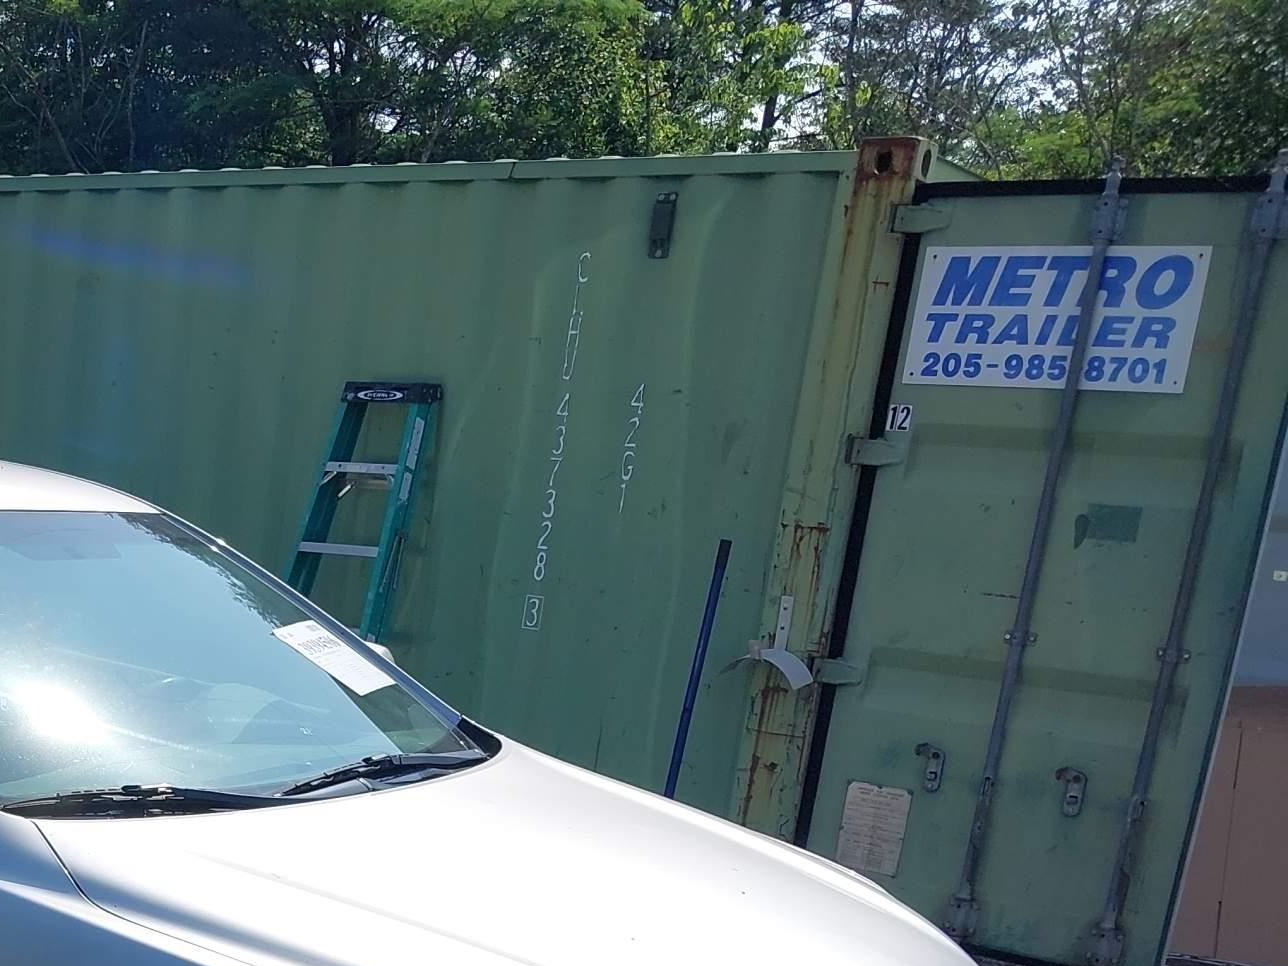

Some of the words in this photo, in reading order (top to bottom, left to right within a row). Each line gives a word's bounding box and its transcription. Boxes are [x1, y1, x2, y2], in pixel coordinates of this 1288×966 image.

[932, 254, 1194, 310] METRO
[925, 313, 1177, 349] TRAILER
[889, 406, 911, 430] 12
